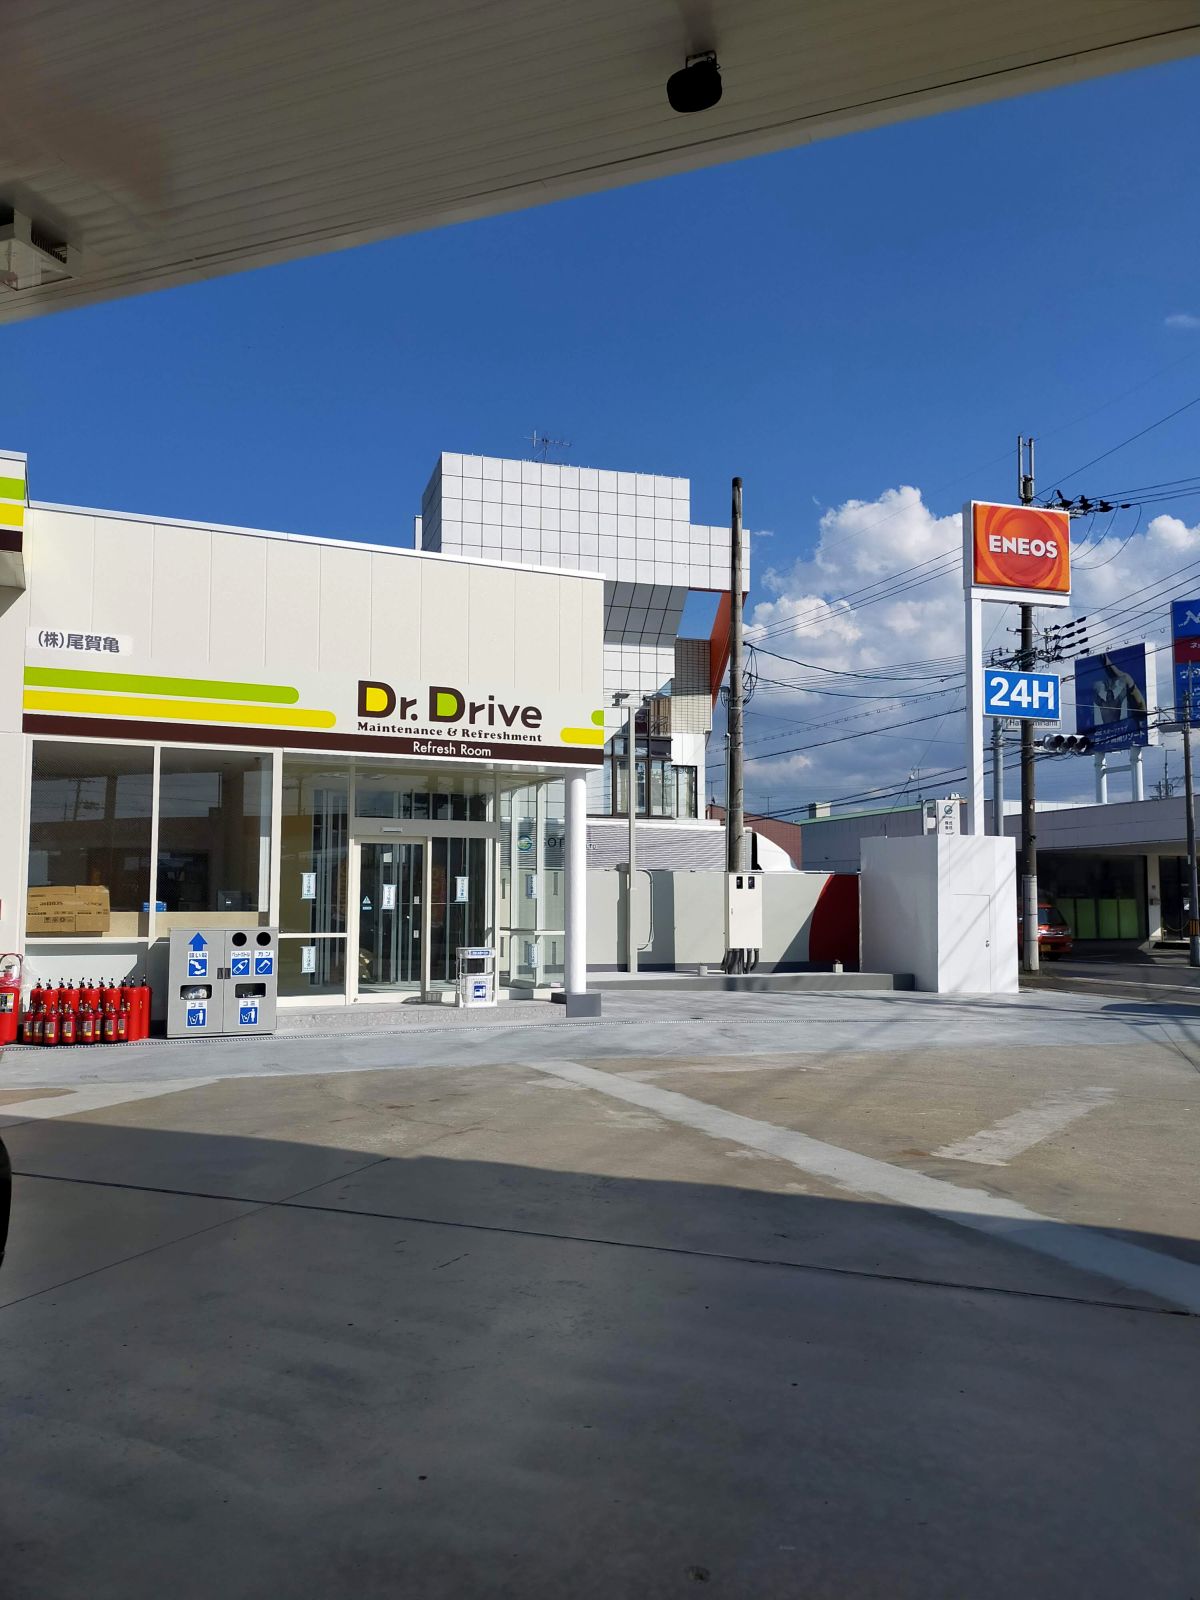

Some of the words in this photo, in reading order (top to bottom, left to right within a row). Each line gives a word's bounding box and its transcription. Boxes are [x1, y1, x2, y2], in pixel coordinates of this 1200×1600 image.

[989, 534, 1058, 559] ENEOS
[38, 630, 120, 653] (株)尾賀亀
[357, 680, 418, 721] Dr.
[429, 686, 542, 728] Drive
[990, 676, 1055, 710] 24H
[357, 721, 443, 736] Maintenance
[447, 727, 458, 737] &
[461, 728, 543, 742] Refreshment
[413, 740, 456, 755] Refresh
[460, 743, 492, 757] Room
